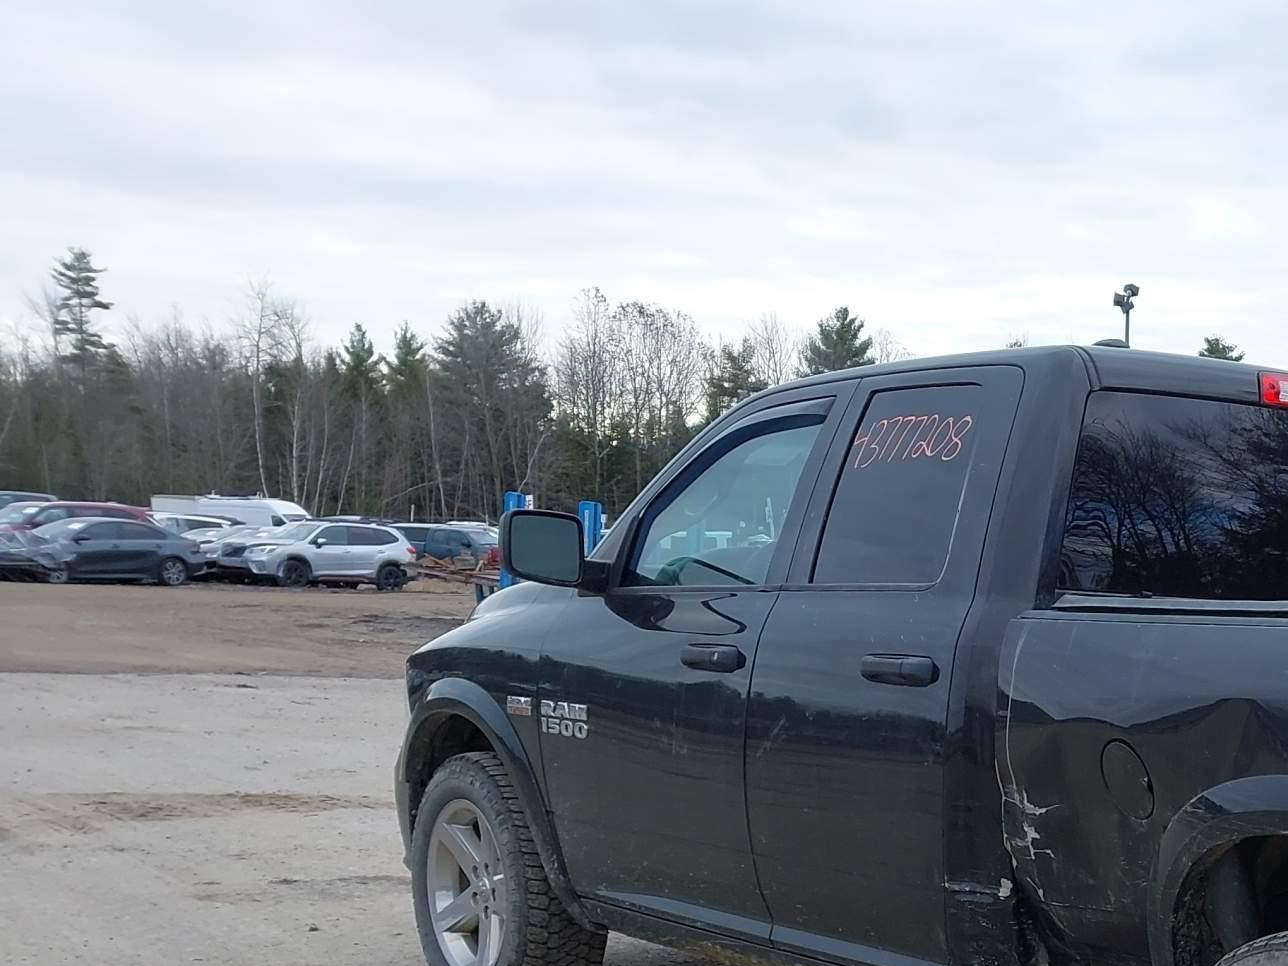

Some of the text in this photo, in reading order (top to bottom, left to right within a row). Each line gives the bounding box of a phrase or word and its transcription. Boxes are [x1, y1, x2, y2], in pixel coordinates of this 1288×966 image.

[853, 413, 974, 469] 43777208
[540, 699, 588, 721] RAM
[541, 717, 588, 739] 1500
